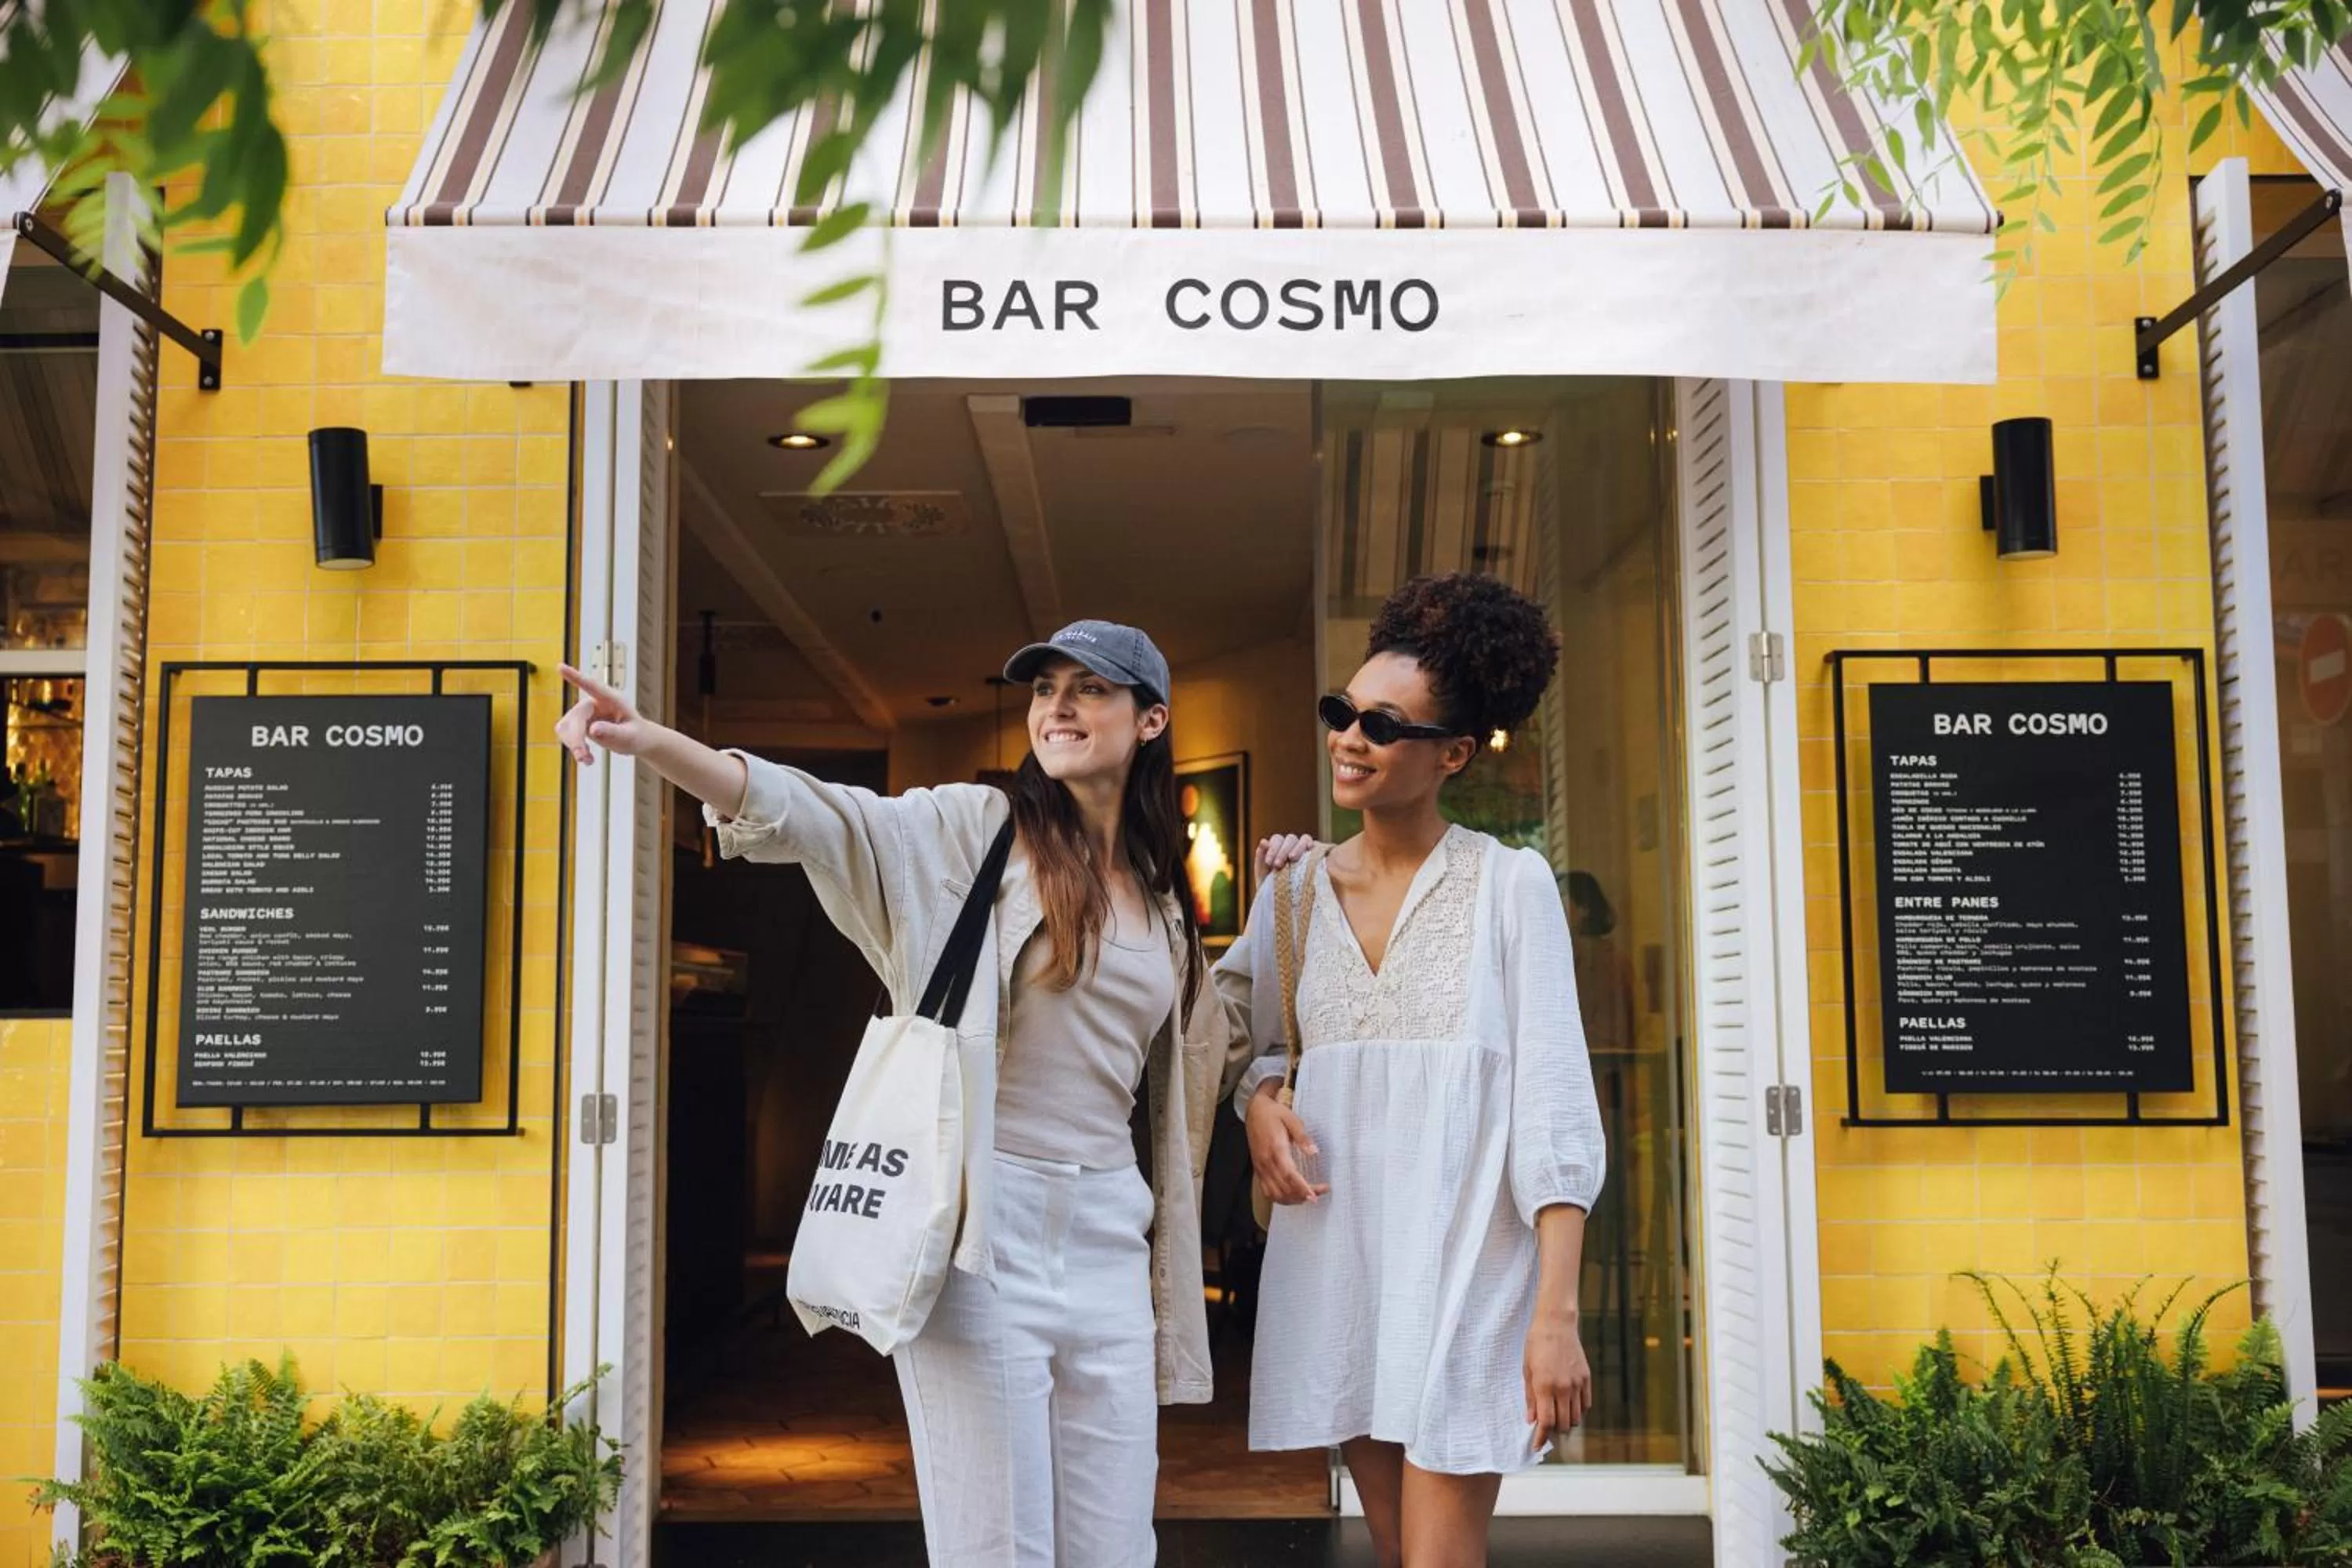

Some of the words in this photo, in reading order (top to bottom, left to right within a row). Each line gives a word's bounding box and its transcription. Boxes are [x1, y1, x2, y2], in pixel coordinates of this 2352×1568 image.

[942, 279, 1100, 331] BAR
[1166, 278, 1439, 332] COSMO
[1933, 714, 1991, 735] BAR
[2009, 713, 2107, 735] COSMO
[251, 726, 309, 746] BAR
[325, 725, 423, 746] COSMO
[1891, 755, 1937, 766] TAPAS
[206, 768, 252, 778] TAPAS
[1894, 896, 1942, 908] ENTRE
[1951, 897, 1998, 908] PANES
[200, 908, 294, 919] SANDWICHES
[1899, 1017, 1965, 1029] PAELLAS
[195, 1034, 261, 1045] PAELLAS
[856, 1143, 909, 1177] AS
